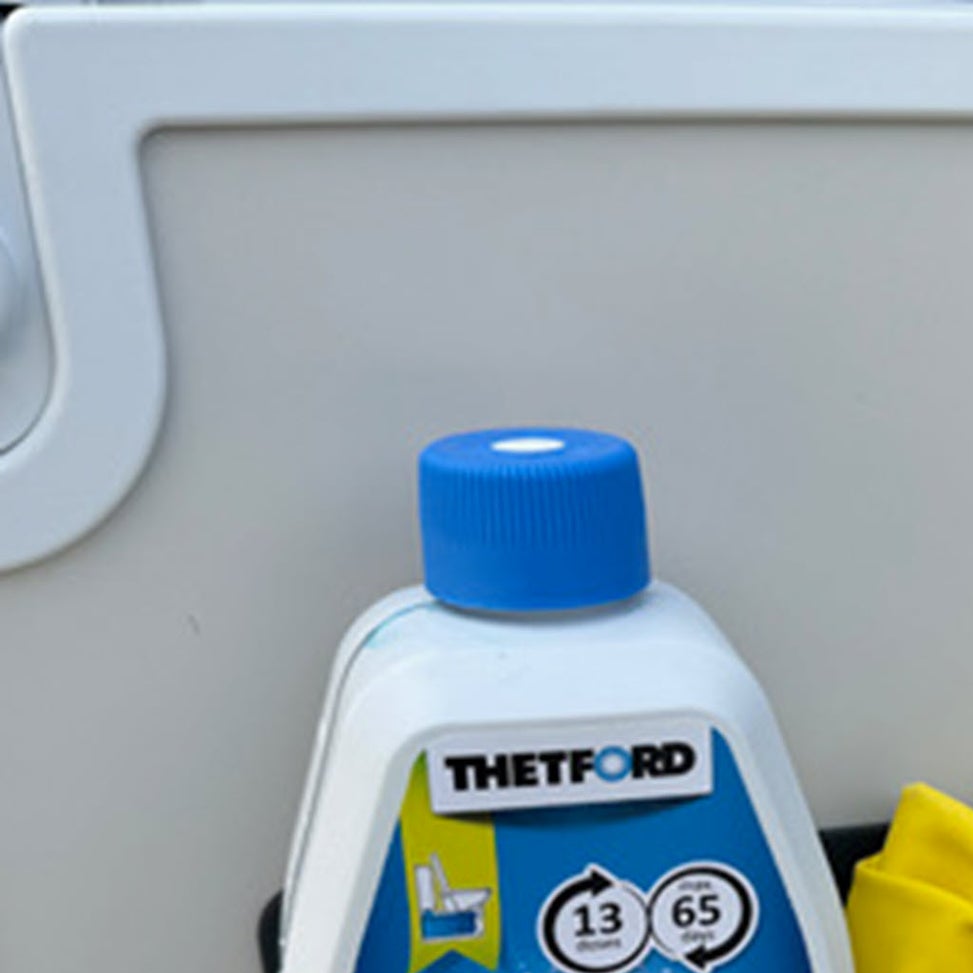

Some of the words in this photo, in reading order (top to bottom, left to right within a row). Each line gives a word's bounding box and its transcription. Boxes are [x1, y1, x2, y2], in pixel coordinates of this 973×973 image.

[444, 741, 697, 791] THETFORD
[573, 902, 622, 937] 13
[671, 894, 721, 928] 65
